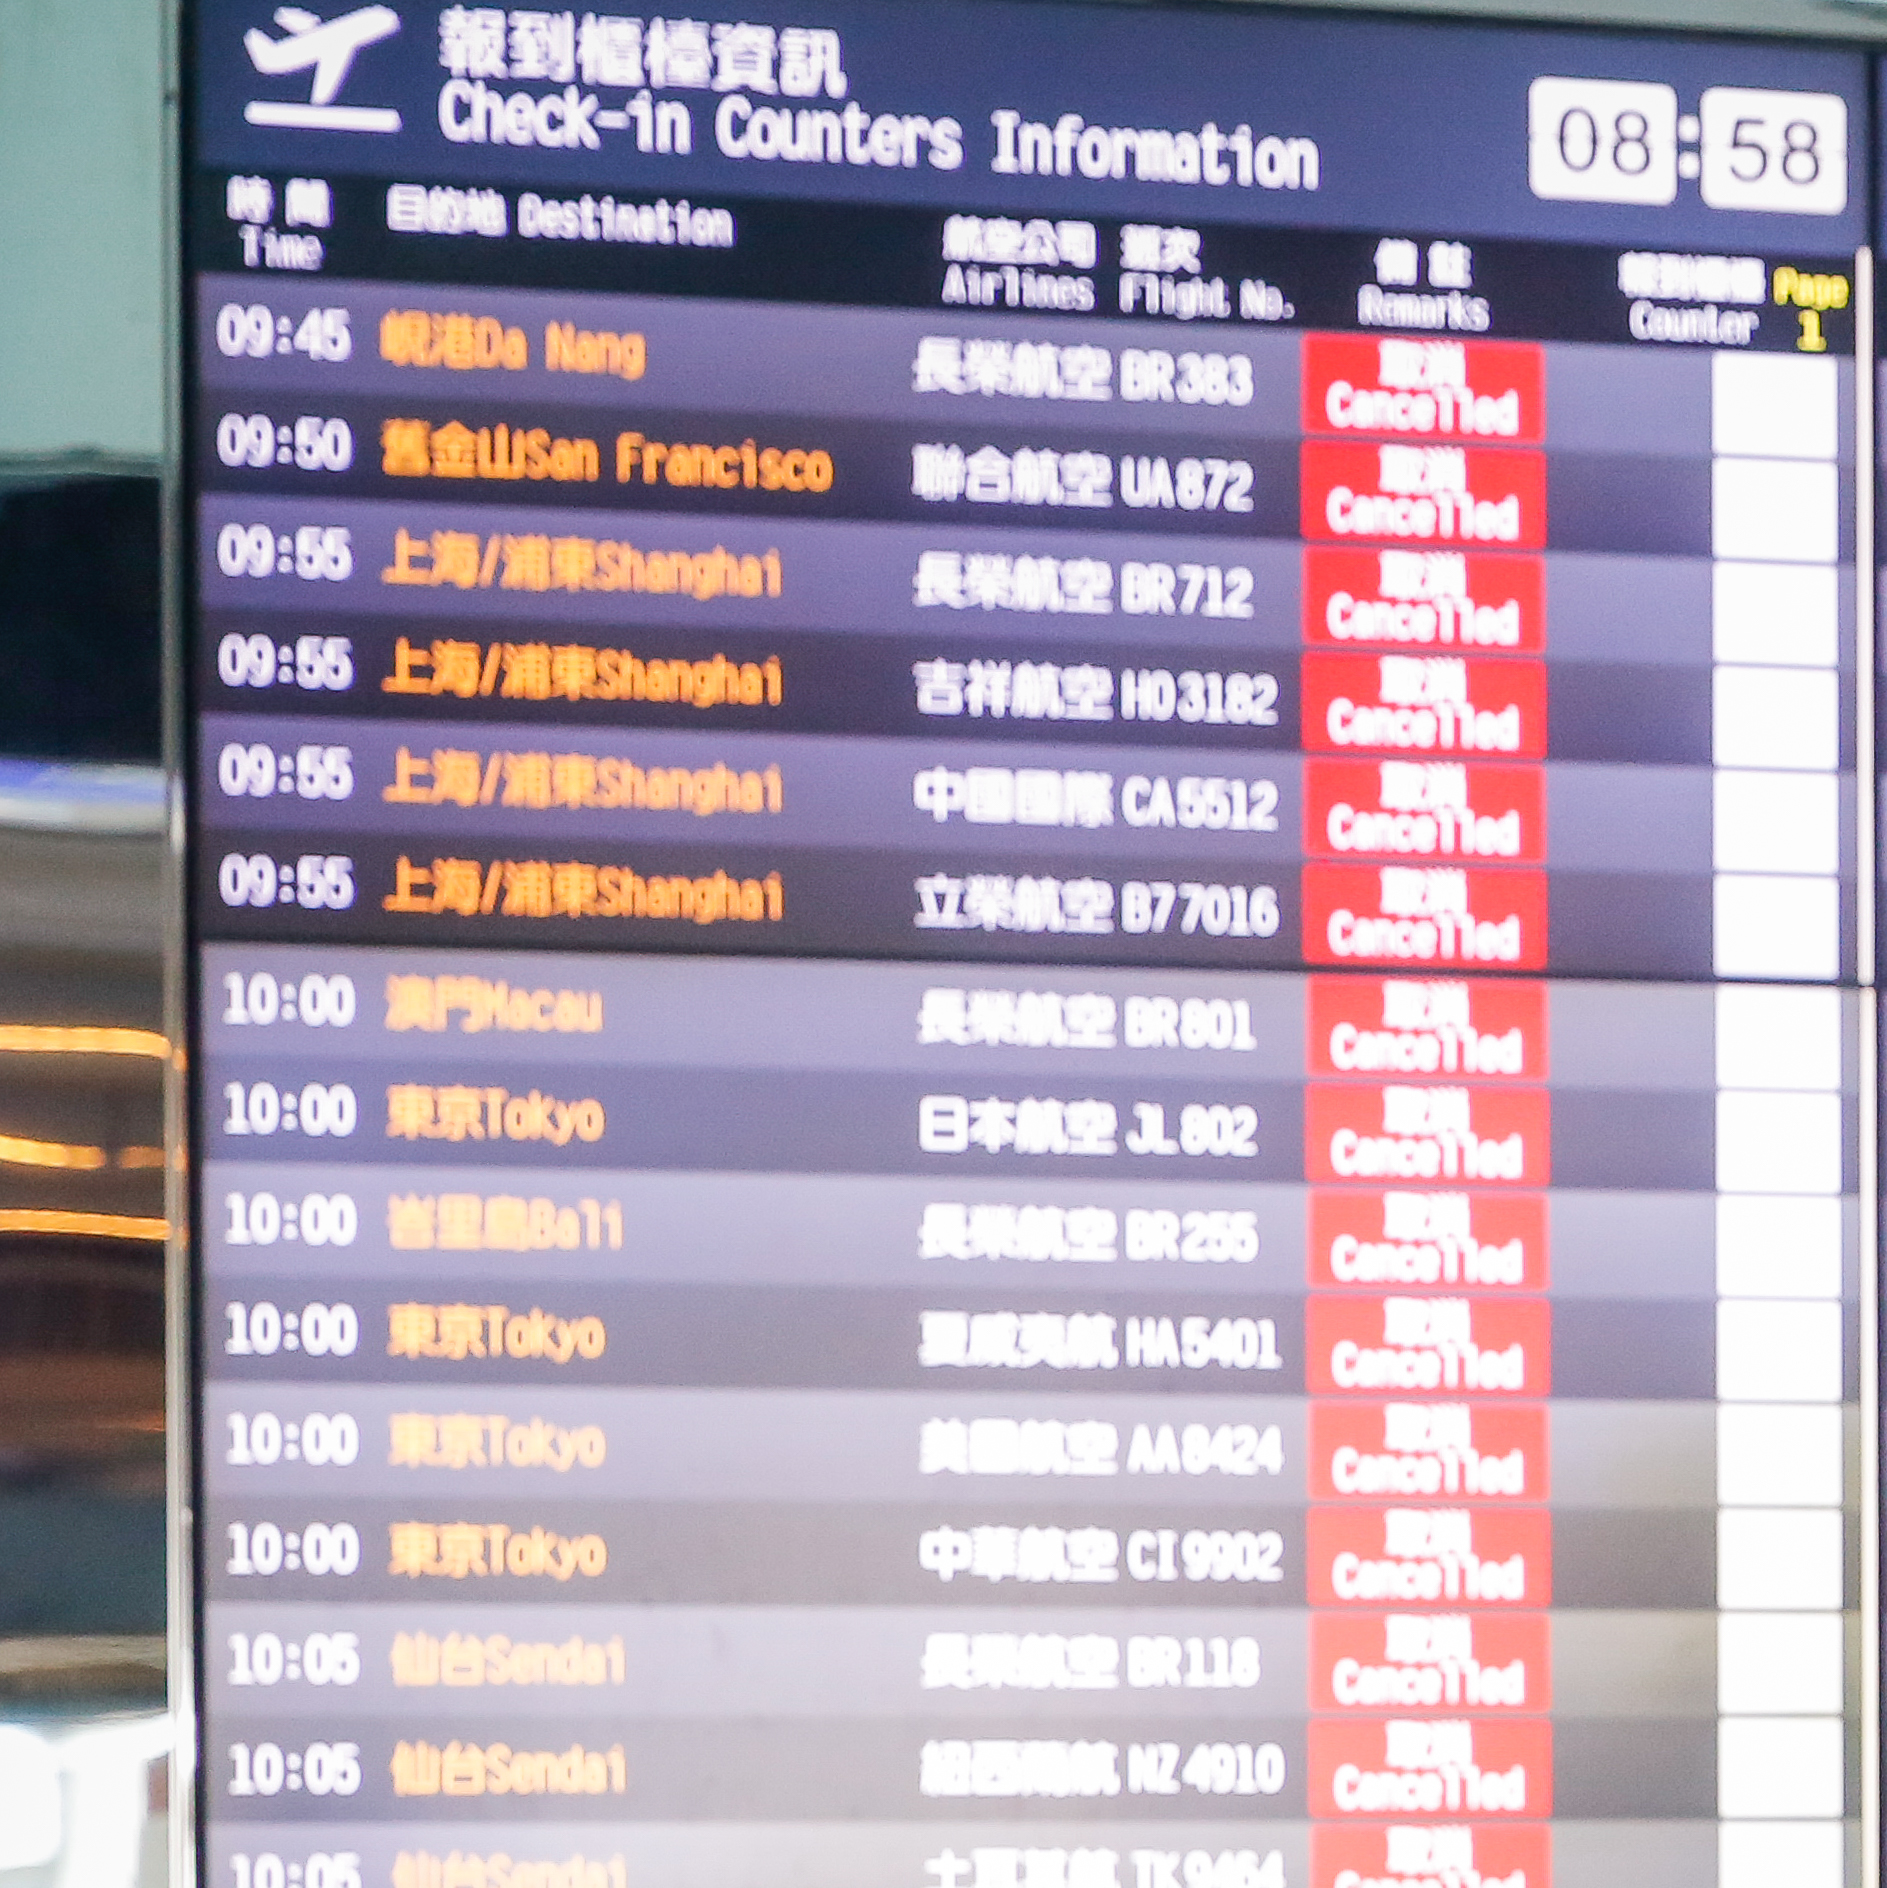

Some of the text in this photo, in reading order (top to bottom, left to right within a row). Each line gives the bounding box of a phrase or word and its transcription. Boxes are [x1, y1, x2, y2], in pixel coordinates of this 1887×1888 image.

[437, 80, 1318, 190] Check-in Counters Information
[240, 224, 322, 269] Time
[518, 194, 733, 245] Destination
[943, 257, 1758, 344] Airlines Flight No. Remarks Counter
[1798, 309, 1827, 352] 1
[217, 304, 351, 361] 09:45
[546, 323, 647, 379] Nang
[1121, 349, 1253, 405] BR383
[1326, 380, 1519, 435] Cancelled
[218, 414, 352, 470] 09:50
[616, 432, 834, 492] Francisco
[1120, 457, 1253, 512] UA872
[218, 525, 352, 580] 09:55
[1121, 563, 1253, 618] BR712
[219, 634, 353, 689] 09:55
[1121, 669, 1277, 724] HO3182
[1327, 697, 1519, 750] Cancelled
[219, 744, 353, 799] 09:55
[1123, 776, 1277, 830] CA5512
[220, 854, 353, 908] 09:55
[1123, 882, 1279, 936] B77016
[225, 973, 1255, 1050] 10:00 BR801
[226, 1083, 356, 1136] 10:00
[387, 1084, 606, 1145] 東京Tokyo
[1126, 1103, 1257, 1156] JL802
[228, 1193, 1258, 1262] 10:00 BR255
[1332, 1233, 1523, 1284] Cancelled
[227, 1303, 1281, 1368] 10:00 HA5401
[229, 1413, 1283, 1475] 10:00 AA8424
[229, 1523, 359, 1574] 10:00
[1127, 1530, 1282, 1580] CI9902
[1333, 1551, 1523, 1599] Cancelled
[230, 1633, 1260, 1687] 10:05 BR118
[230, 1743, 1285, 1794] 10:05 NZ4910
